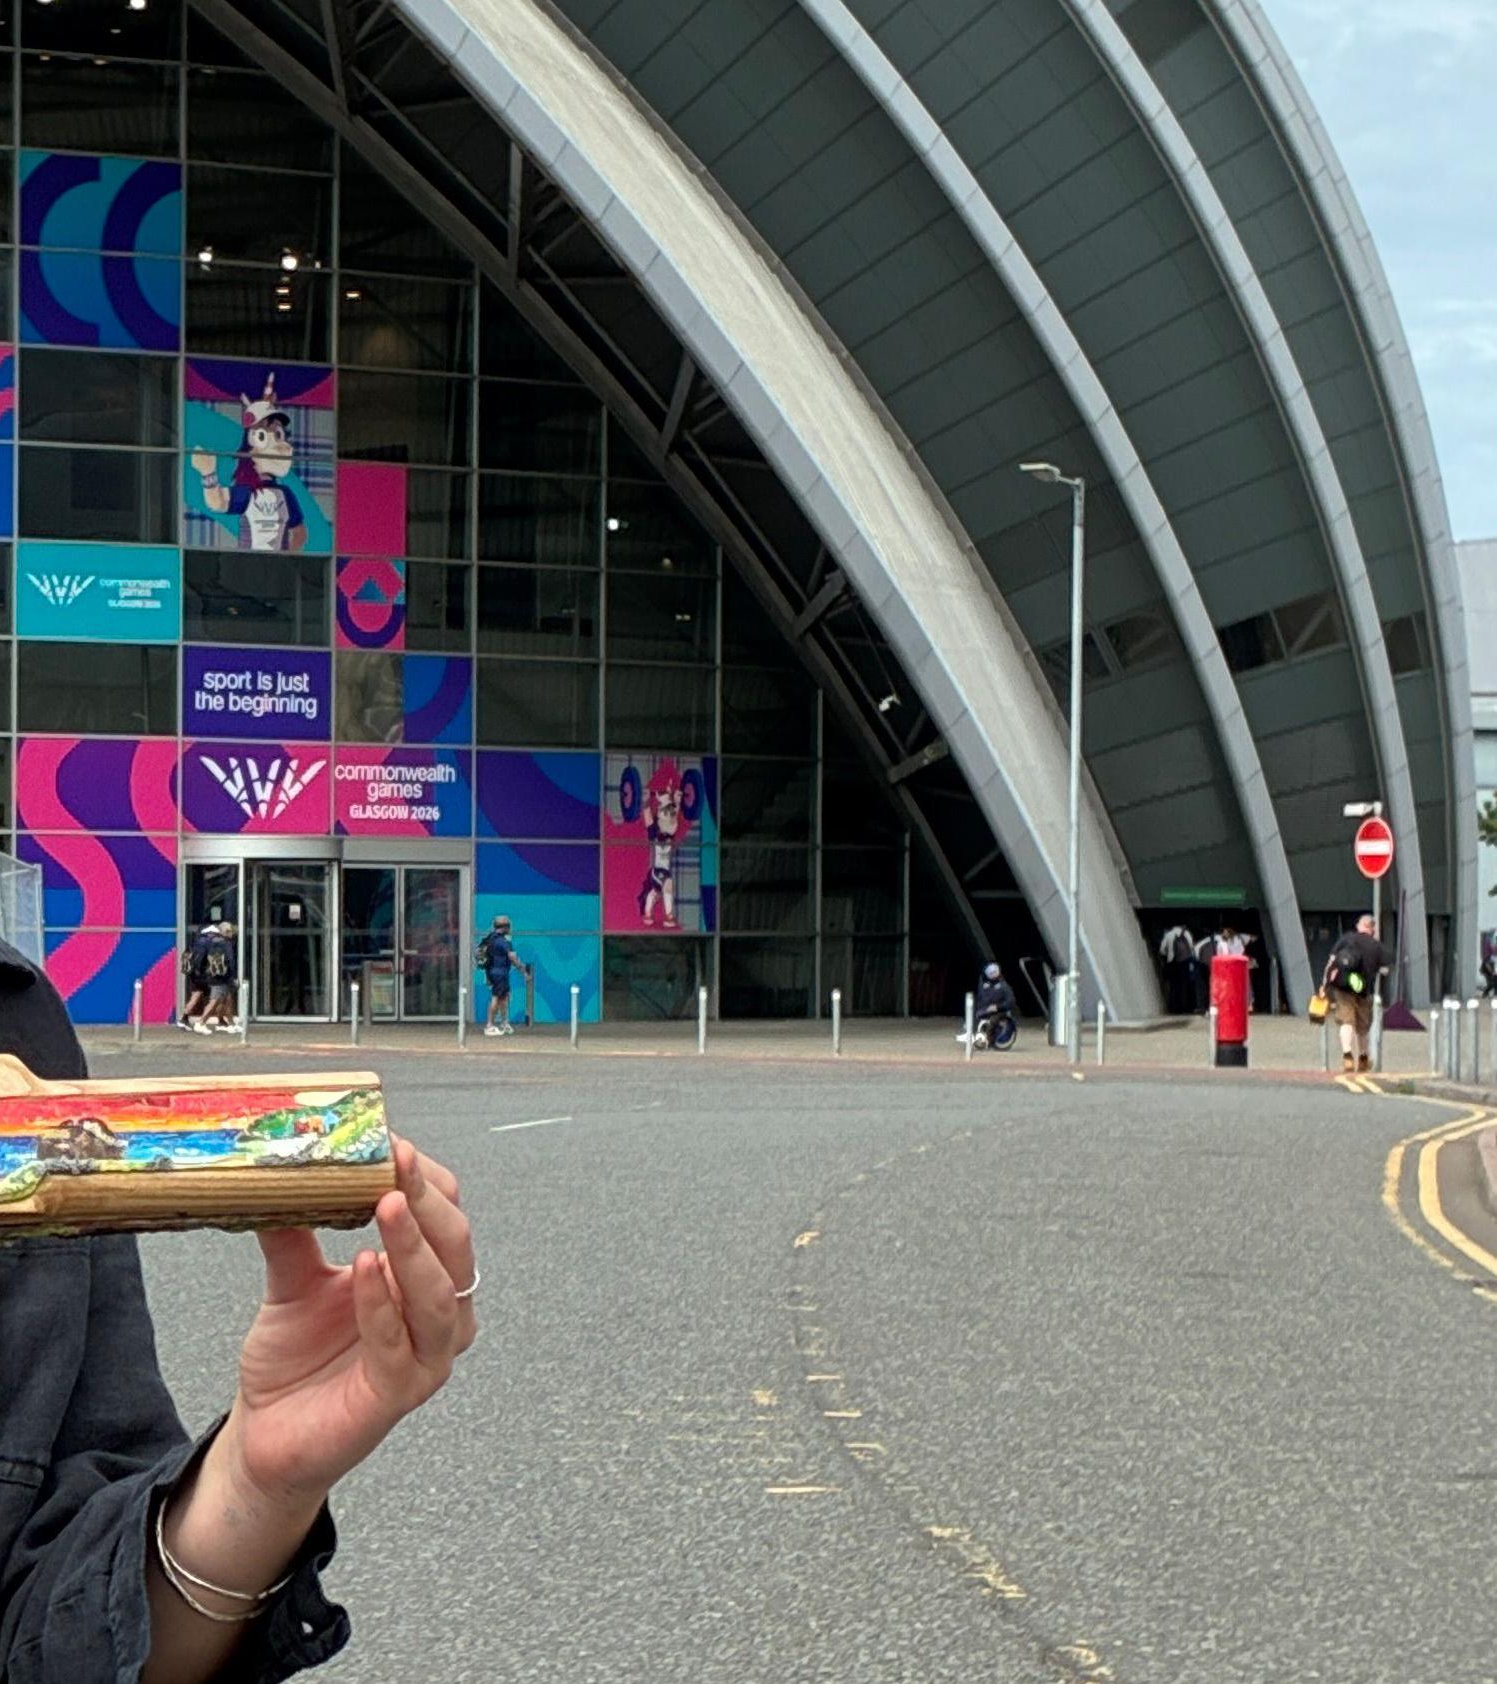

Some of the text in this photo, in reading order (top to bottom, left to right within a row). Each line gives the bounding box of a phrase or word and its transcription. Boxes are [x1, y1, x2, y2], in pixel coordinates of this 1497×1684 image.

[203, 670, 309, 695] sport is just
[194, 690, 318, 719] the beginning
[334, 764, 456, 782] commonwealth
[367, 782, 423, 802] games
[349, 804, 441, 821] GLASGOW 2026
